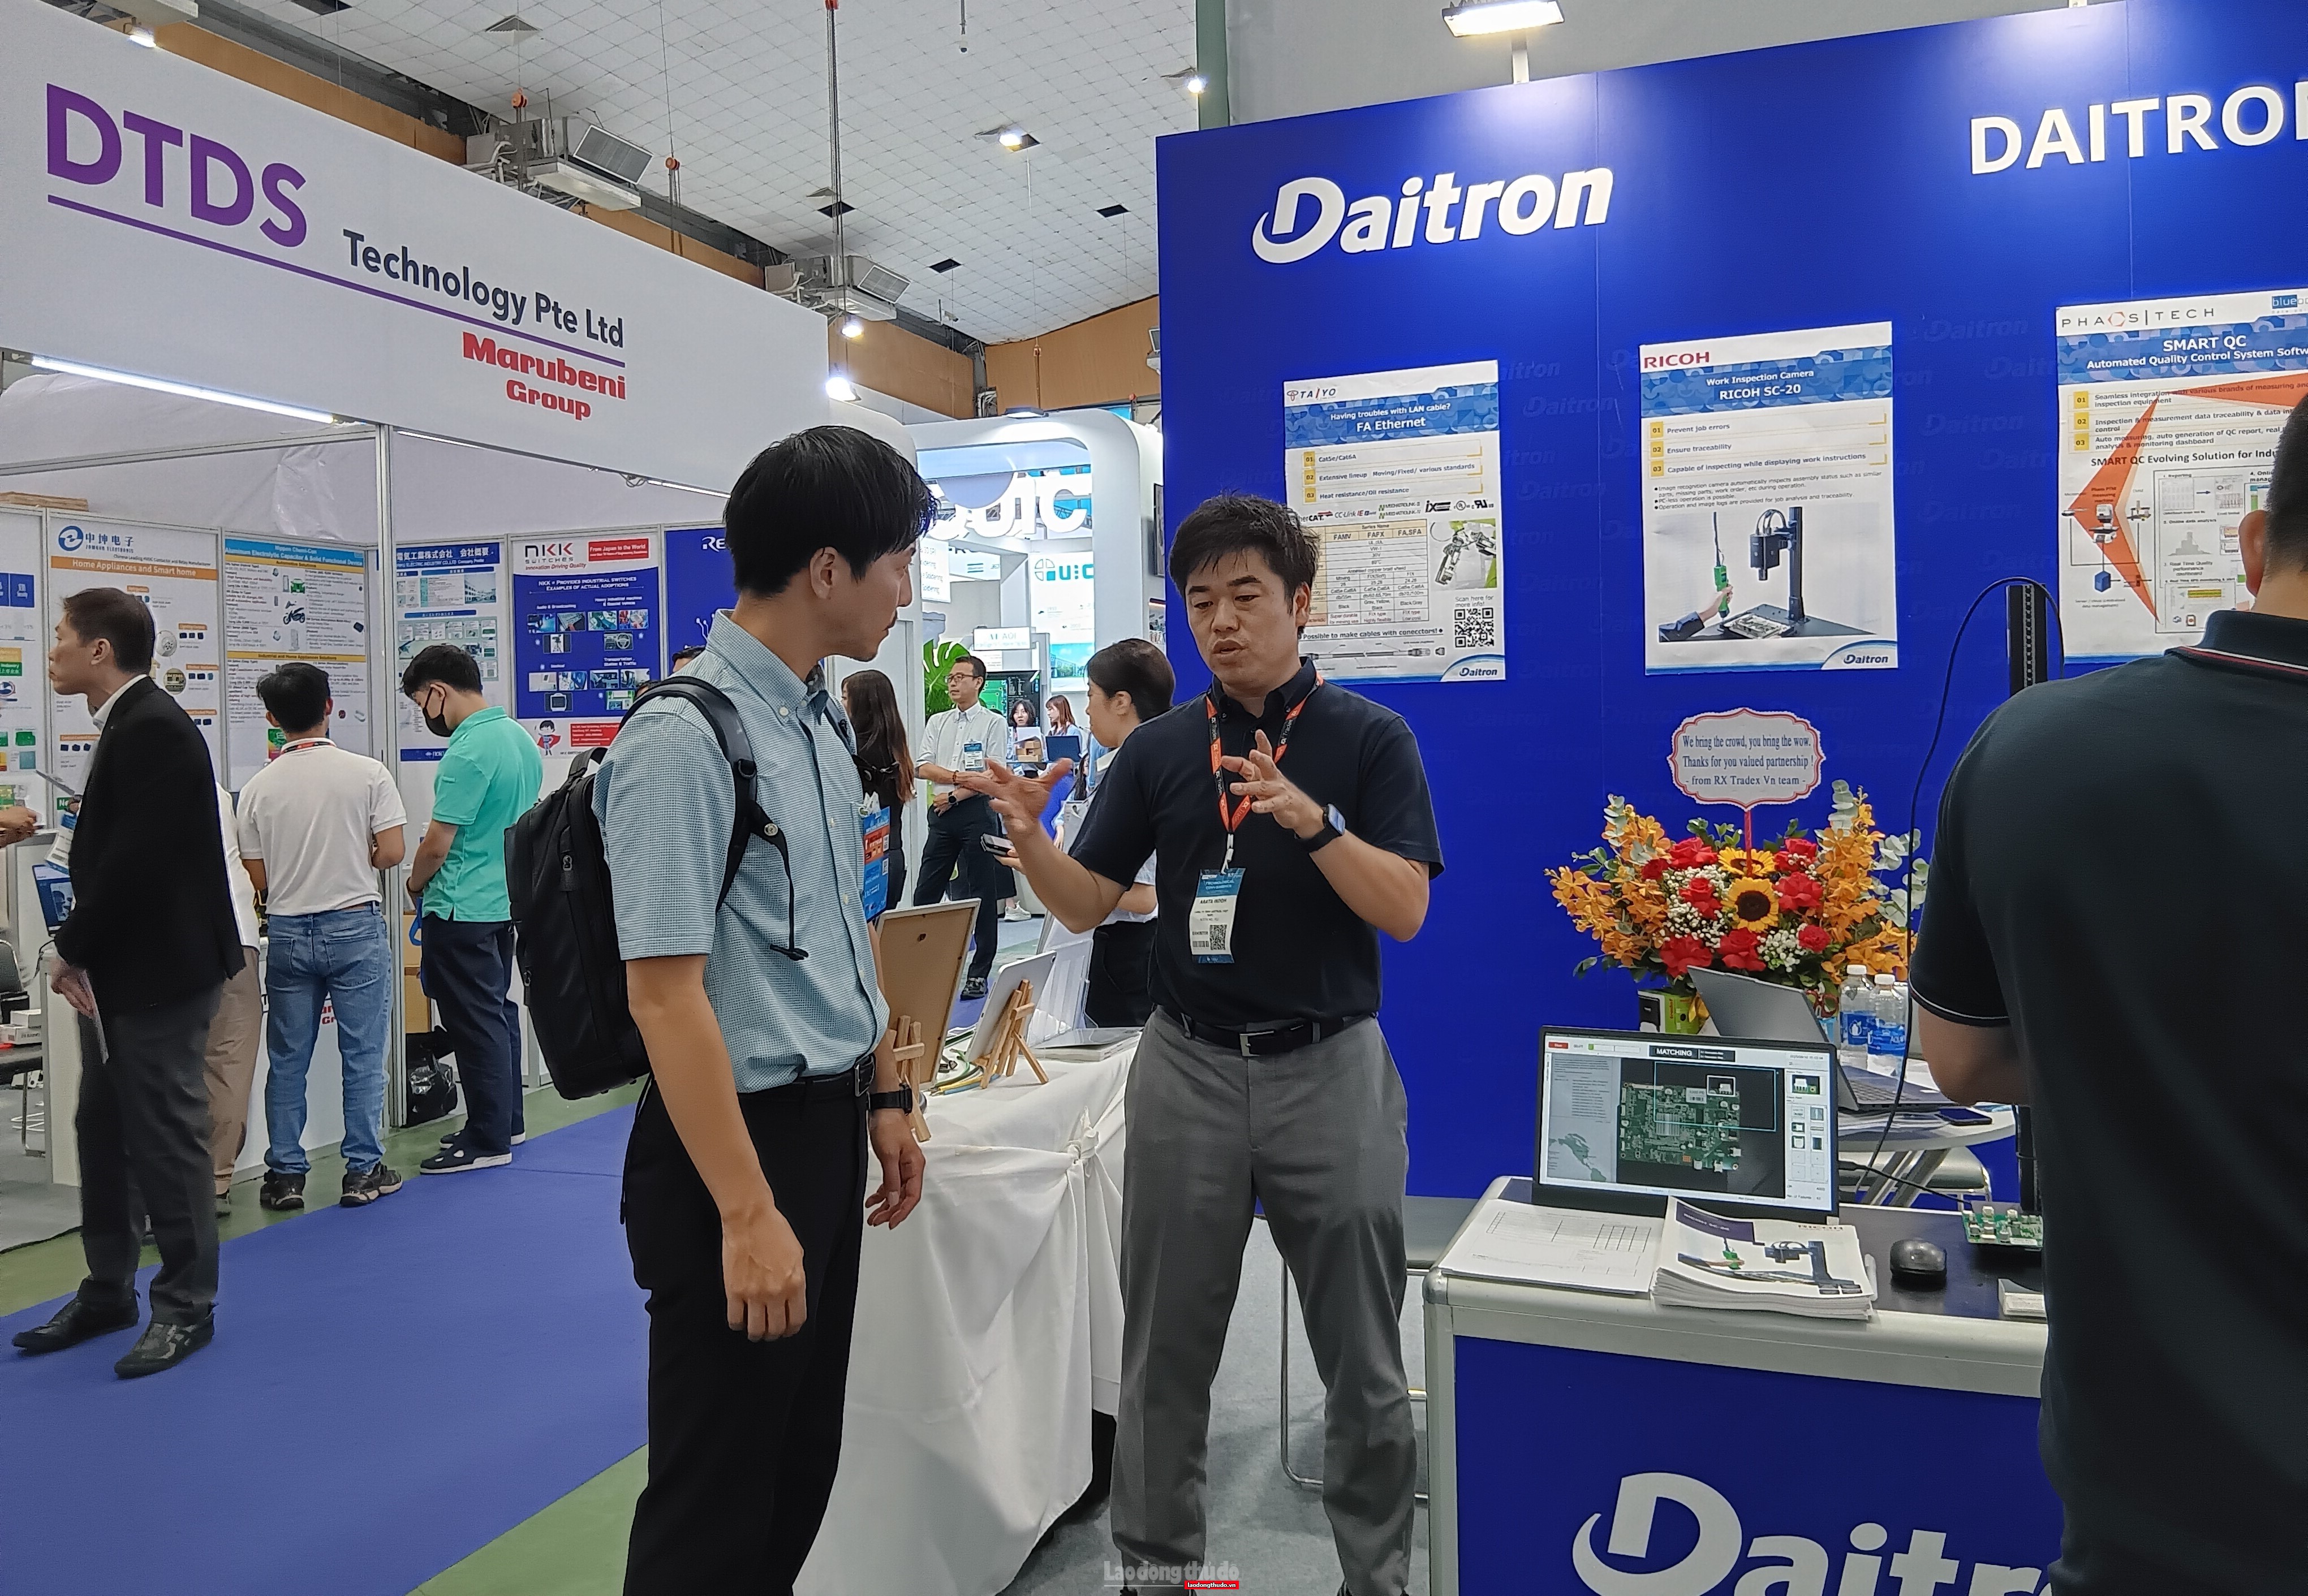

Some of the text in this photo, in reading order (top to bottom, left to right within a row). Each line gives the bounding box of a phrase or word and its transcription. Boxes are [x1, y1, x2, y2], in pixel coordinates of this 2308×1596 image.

[1971, 80, 2308, 174] DAITRO
[46, 83, 307, 247] DTDS
[1252, 167, 1613, 264] Daitron
[343, 228, 623, 349] Technology Pte Ltd
[2163, 335, 2246, 352] SMART QC
[462, 331, 626, 400] Marubeni
[1644, 351, 1710, 368] RICOH
[2087, 346, 2308, 369] Automated Quality Control System Softw
[1706, 370, 1814, 386] Work Inspection Camera
[506, 379, 590, 421] Group
[1720, 384, 1801, 400] RICOH SC-20
[2095, 399, 2131, 408] inspection
[1330, 412, 1356, 421] Having
[1426, 403, 1450, 412] cable?
[1357, 417, 1426, 432] FA Ethernet
[1693, 443, 1732, 452] traceability
[1668, 465, 1695, 474] Capable
[1706, 461, 1742, 471] inspecting
[1764, 457, 1801, 468] displaying
[1823, 452, 1866, 462] instructions
[2091, 456, 2127, 467] SMART
[2130, 456, 2145, 464] QC
[2148, 454, 2189, 464] Evolving
[2192, 451, 2234, 461] Solution
[1319, 473, 1347, 481] Extensive
[1349, 472, 1367, 480] lineup
[97, 562, 137, 572] Appliances
[153, 566, 175, 574] Smart
[176, 567, 196, 576] home
[1844, 654, 1888, 665] Daitron
[1459, 667, 1497, 677] Daitron
[1682, 735, 1811, 750] We bring the crowd, you bring the wow.
[1682, 756, 1708, 767] Thanks
[1711, 756, 1721, 767] for
[1724, 758, 1737, 770] you
[1739, 756, 1763, 767] valued
[1766, 755, 1808, 770] partnership
[1691, 776, 1711, 785] from
[1714, 776, 1727, 785] RX
[1730, 775, 1760, 785] Tradex
[1763, 776, 1775, 784] Vn
[1656, 1048, 1692, 1056] MATCHING
[1573, 1472, 2051, 1596] Daitr
